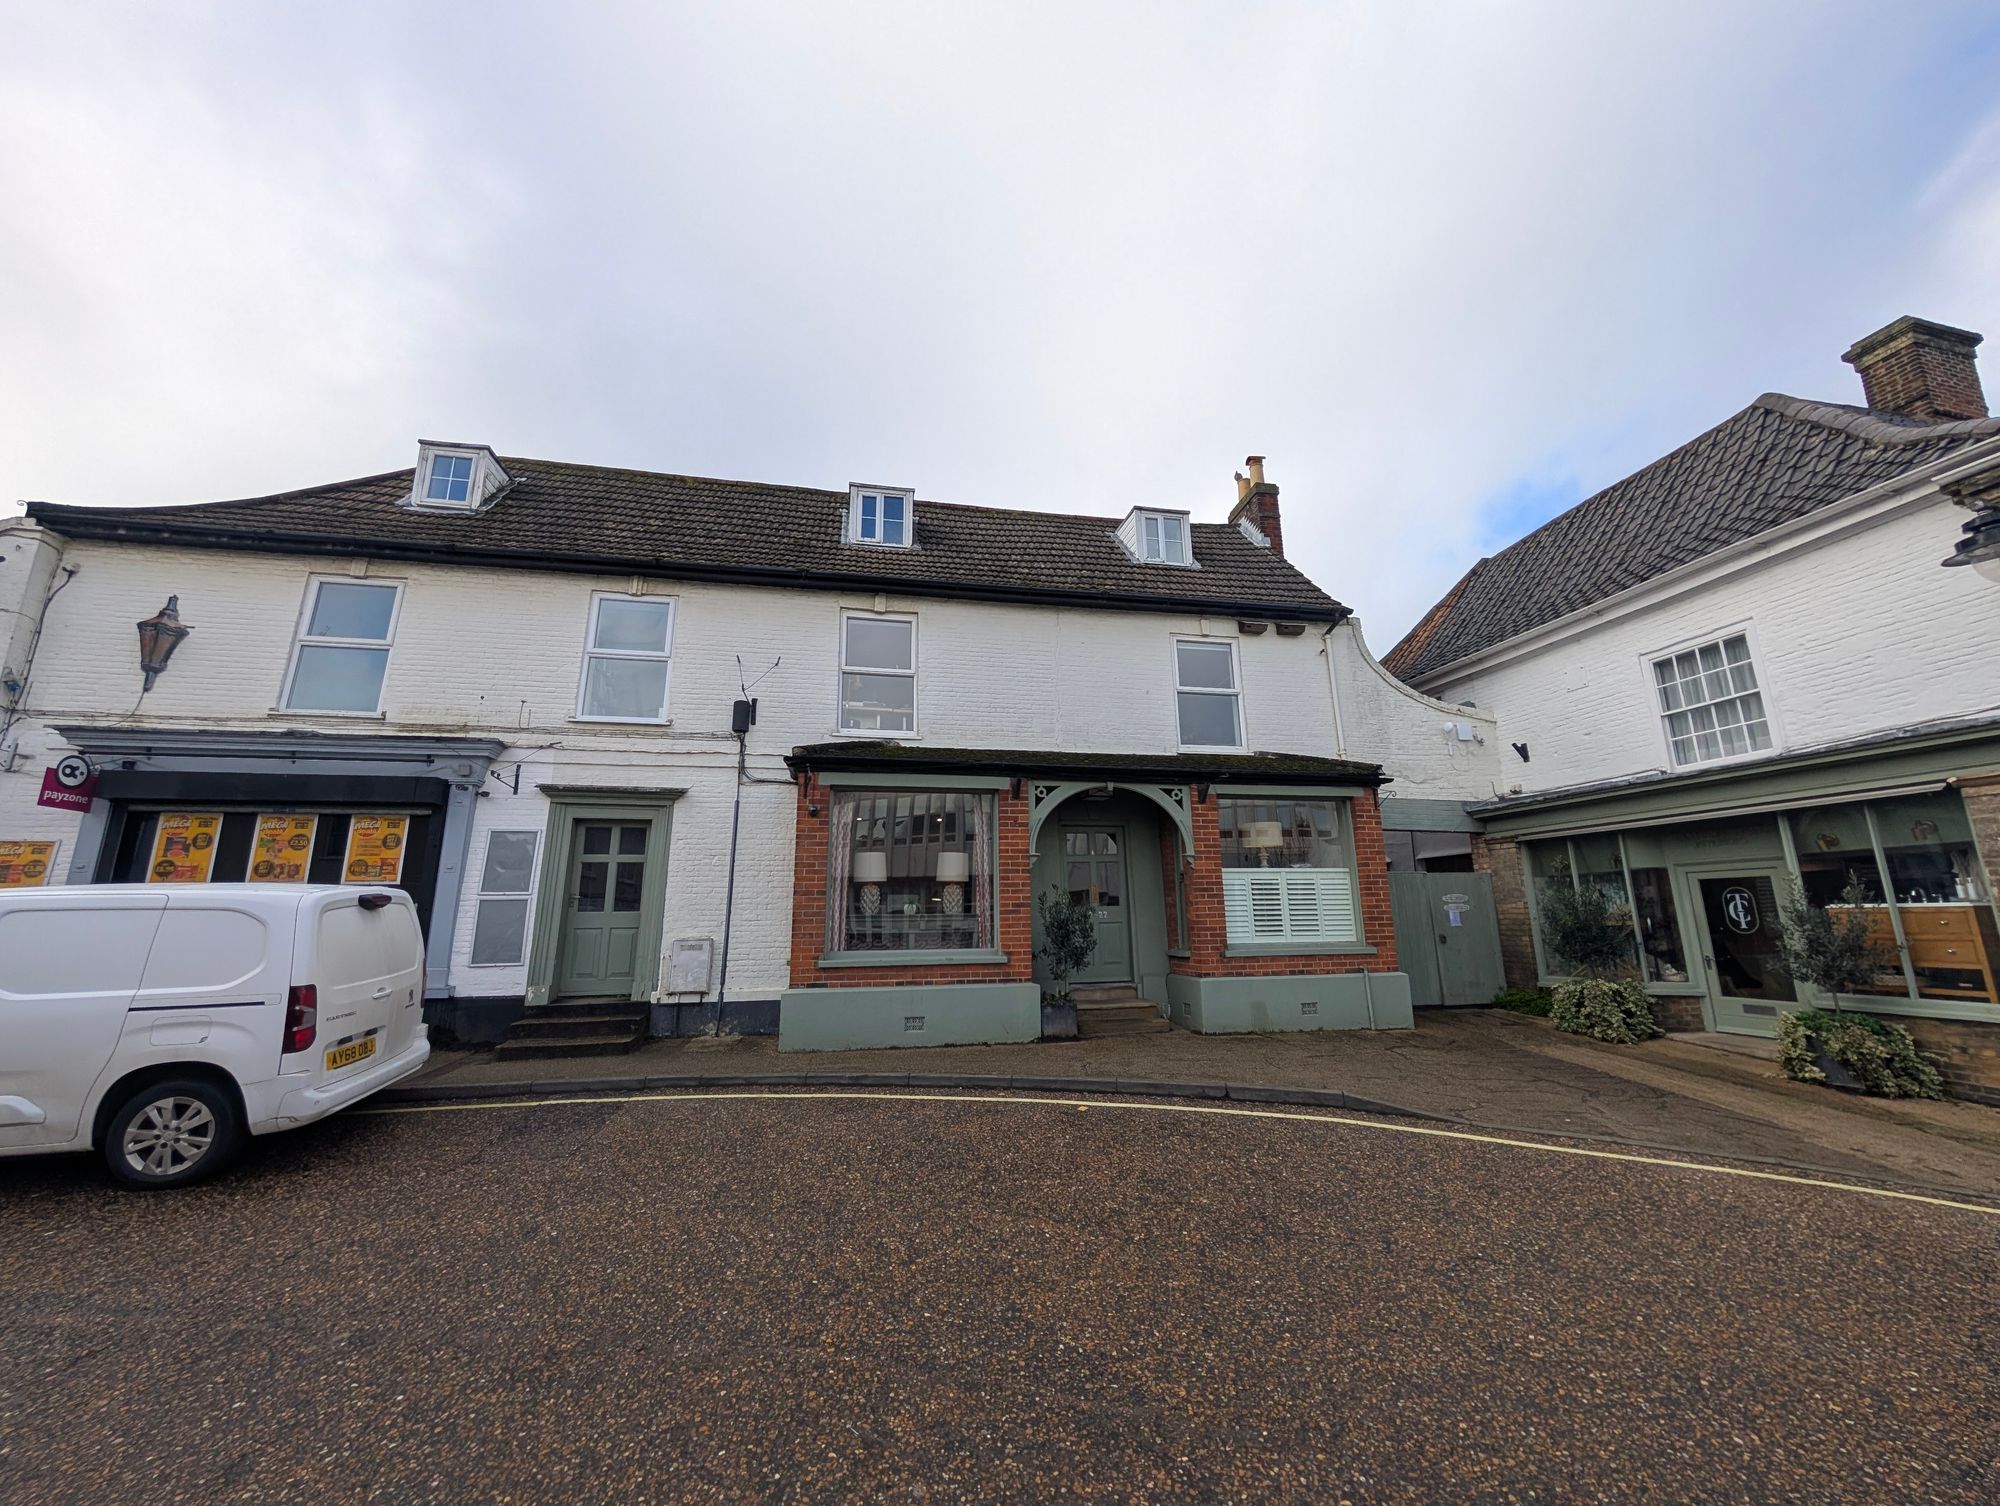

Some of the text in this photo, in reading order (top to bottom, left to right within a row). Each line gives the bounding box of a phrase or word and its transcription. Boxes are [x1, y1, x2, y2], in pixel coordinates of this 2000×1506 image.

[43, 790, 89, 804] payzone
[260, 820, 288, 830] MEGA
[354, 819, 381, 830] MEGA
[331, 1046, 357, 1066] AY68
